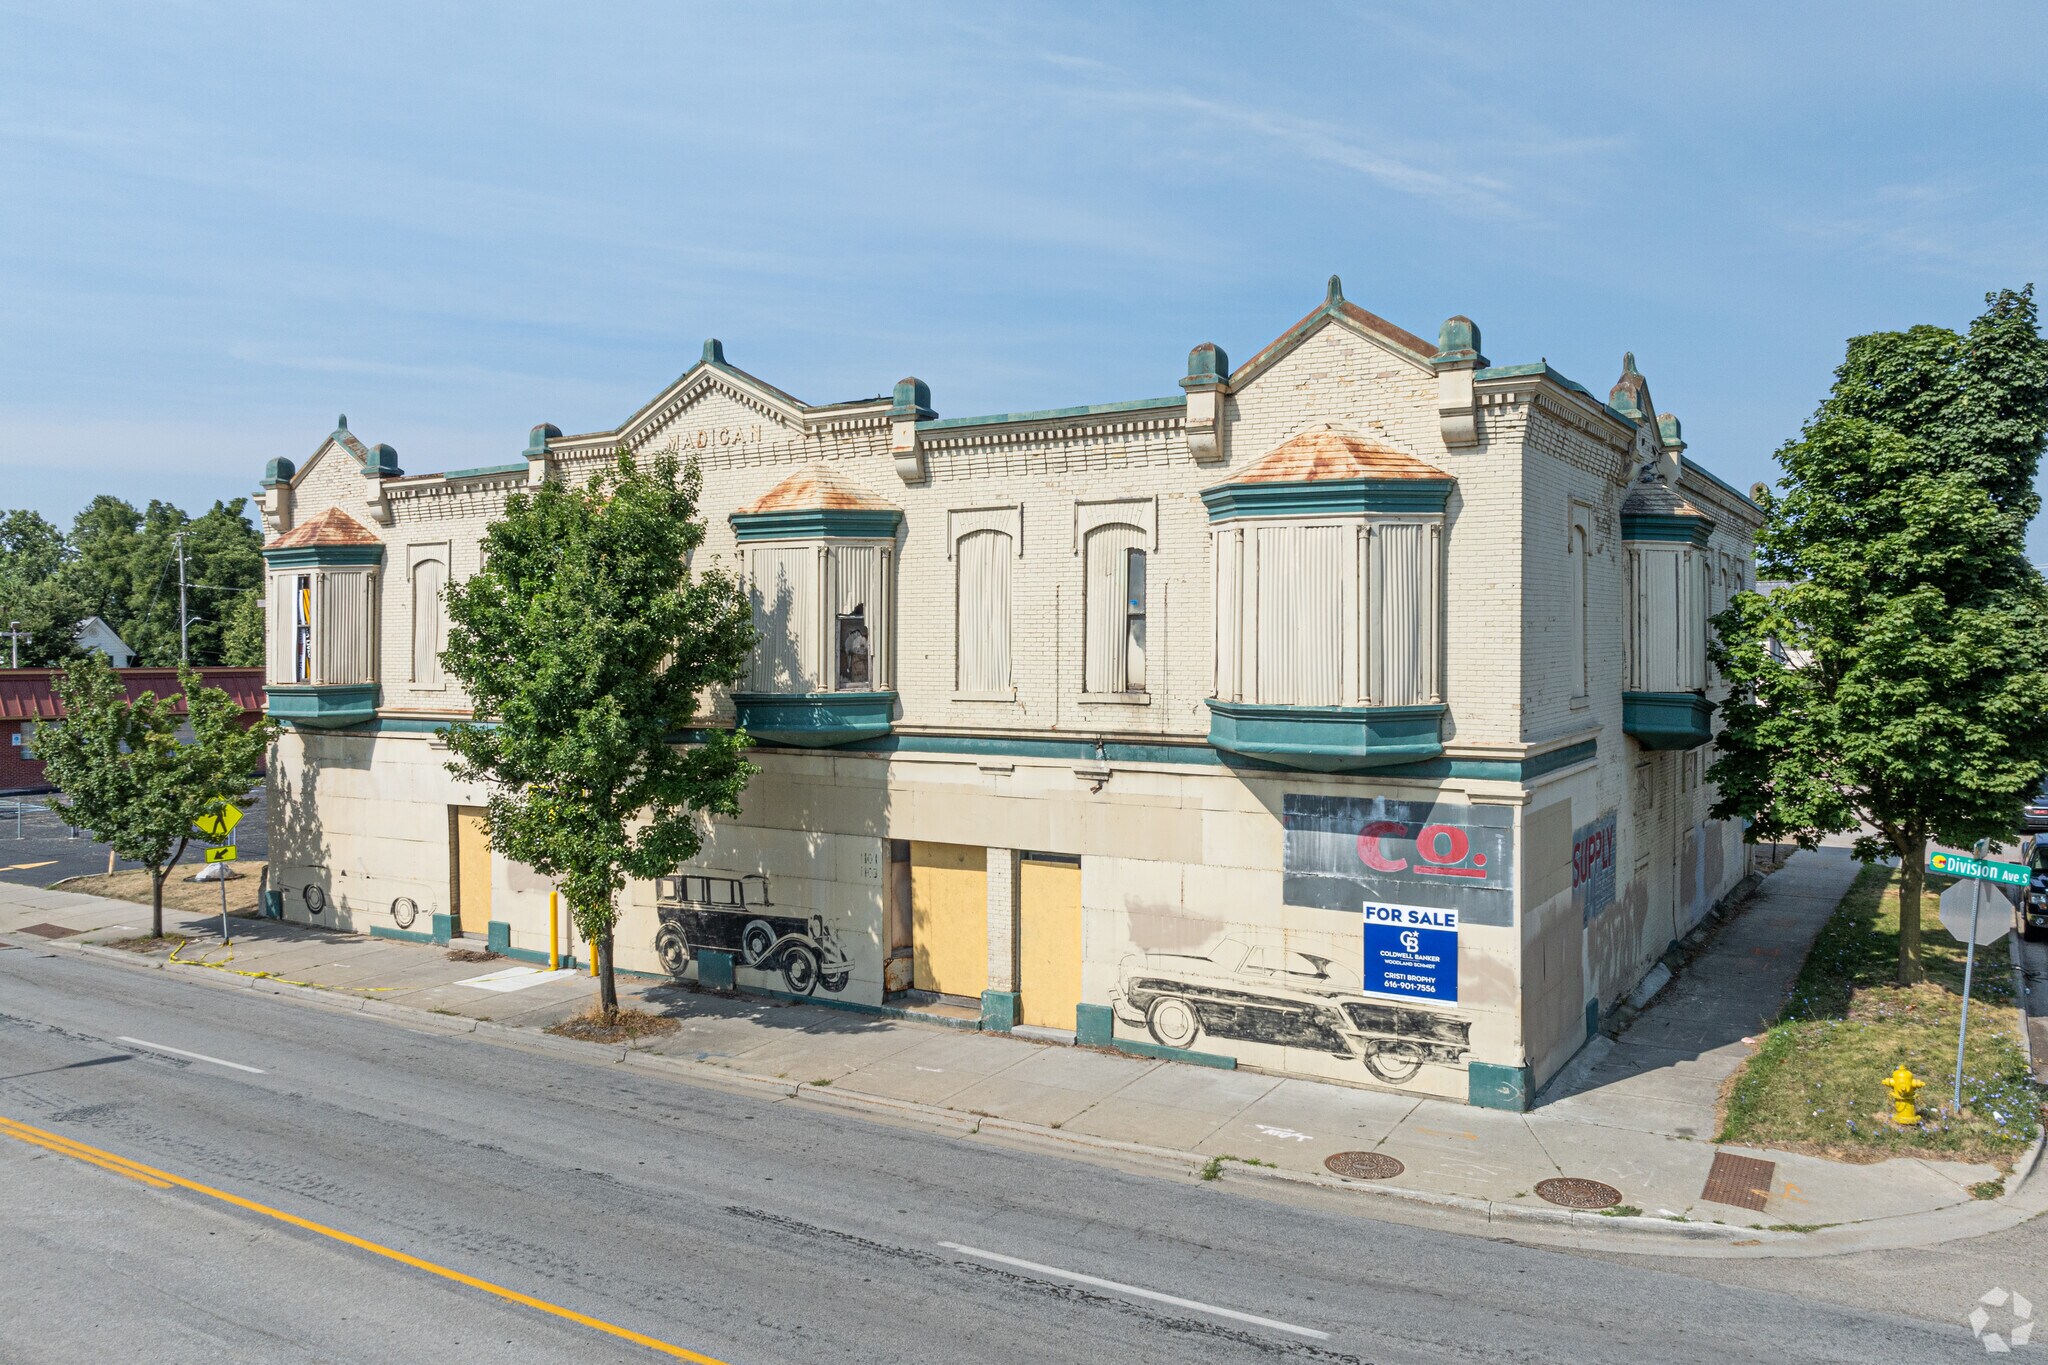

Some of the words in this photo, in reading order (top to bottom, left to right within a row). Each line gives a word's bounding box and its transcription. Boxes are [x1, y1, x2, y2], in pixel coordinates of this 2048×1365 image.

[1573, 824, 1614, 888] SUPPLY
[1947, 857, 1998, 879] Division
[2002, 871, 2019, 883] Ave
[2022, 873, 2029, 884] S
[1366, 906, 1402, 922] FOR
[1408, 910, 1455, 927] SALE
[1380, 950, 1413, 960] COLDWELL
[1414, 954, 1440, 962] BANKER
[1384, 959, 1413, 967] WOODLAND
[1384, 972, 1406, 980] CRISTI
[1407, 974, 1436, 983] BROPHY
[1384, 980, 1436, 993] 616-901-7556
